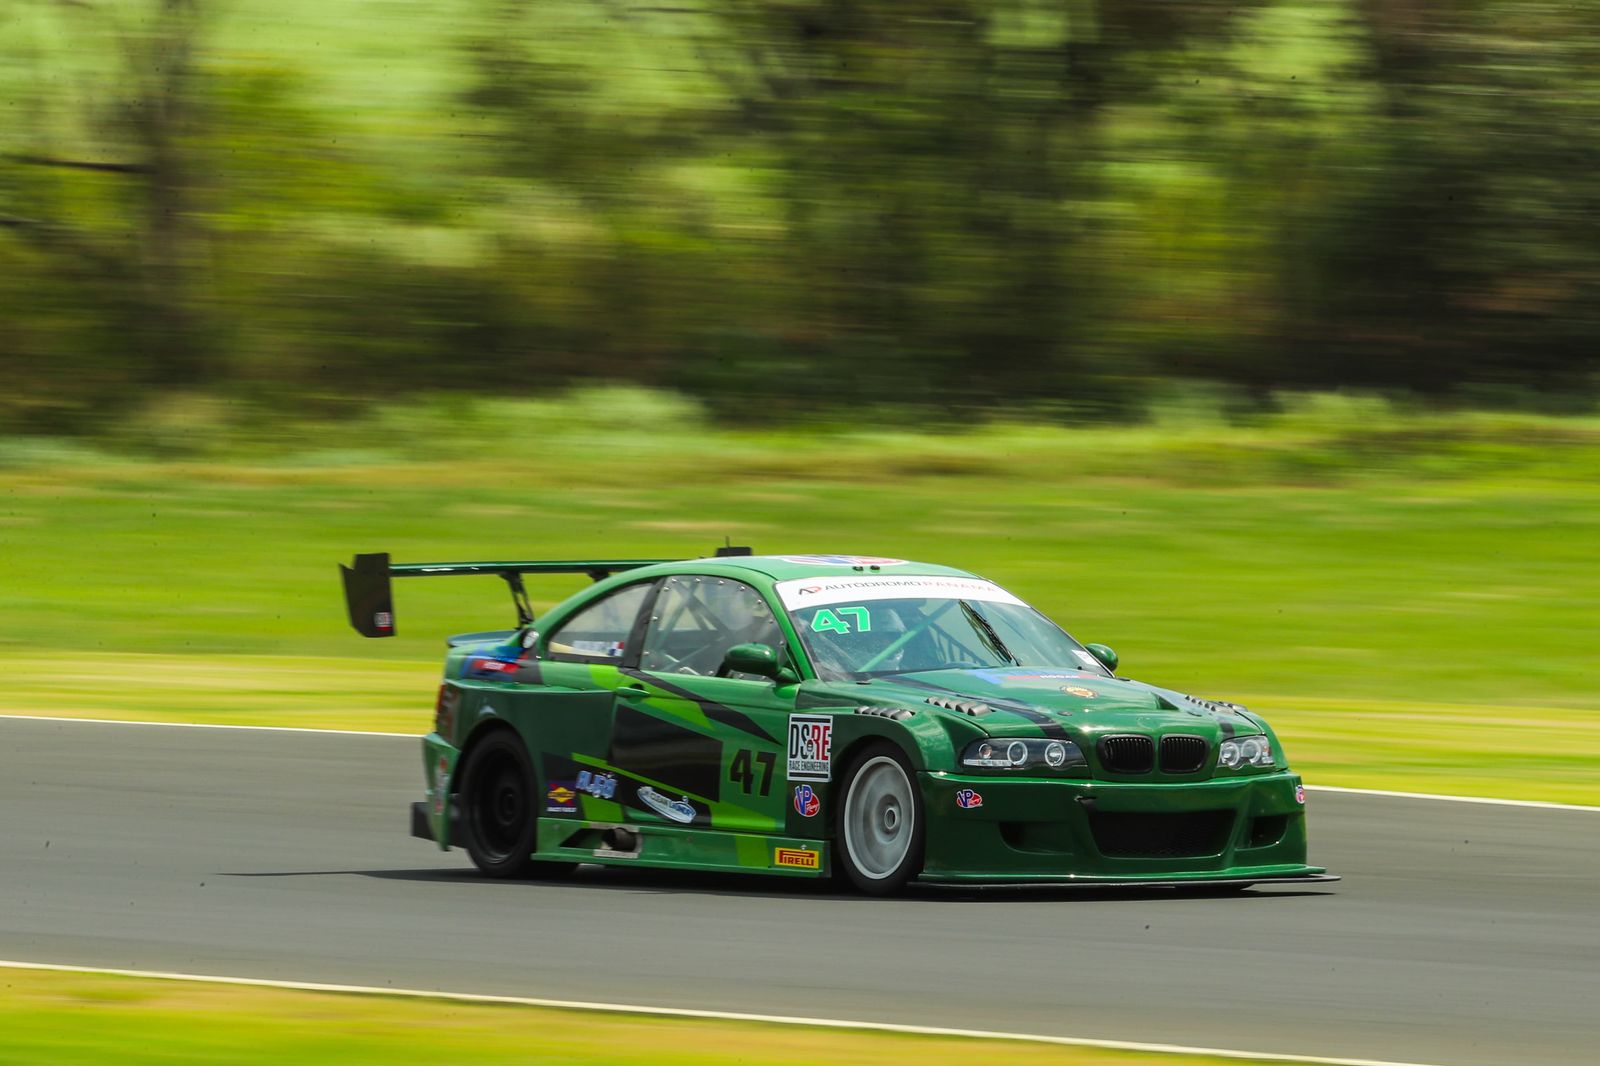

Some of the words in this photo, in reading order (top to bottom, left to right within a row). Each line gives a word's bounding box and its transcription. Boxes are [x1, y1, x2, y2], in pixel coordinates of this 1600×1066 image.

[825, 580, 922, 591] AUTODROMO
[810, 606, 871, 634] 47
[729, 749, 777, 797] 47
[795, 784, 813, 816] VP
[779, 850, 815, 866] PIRELLI
